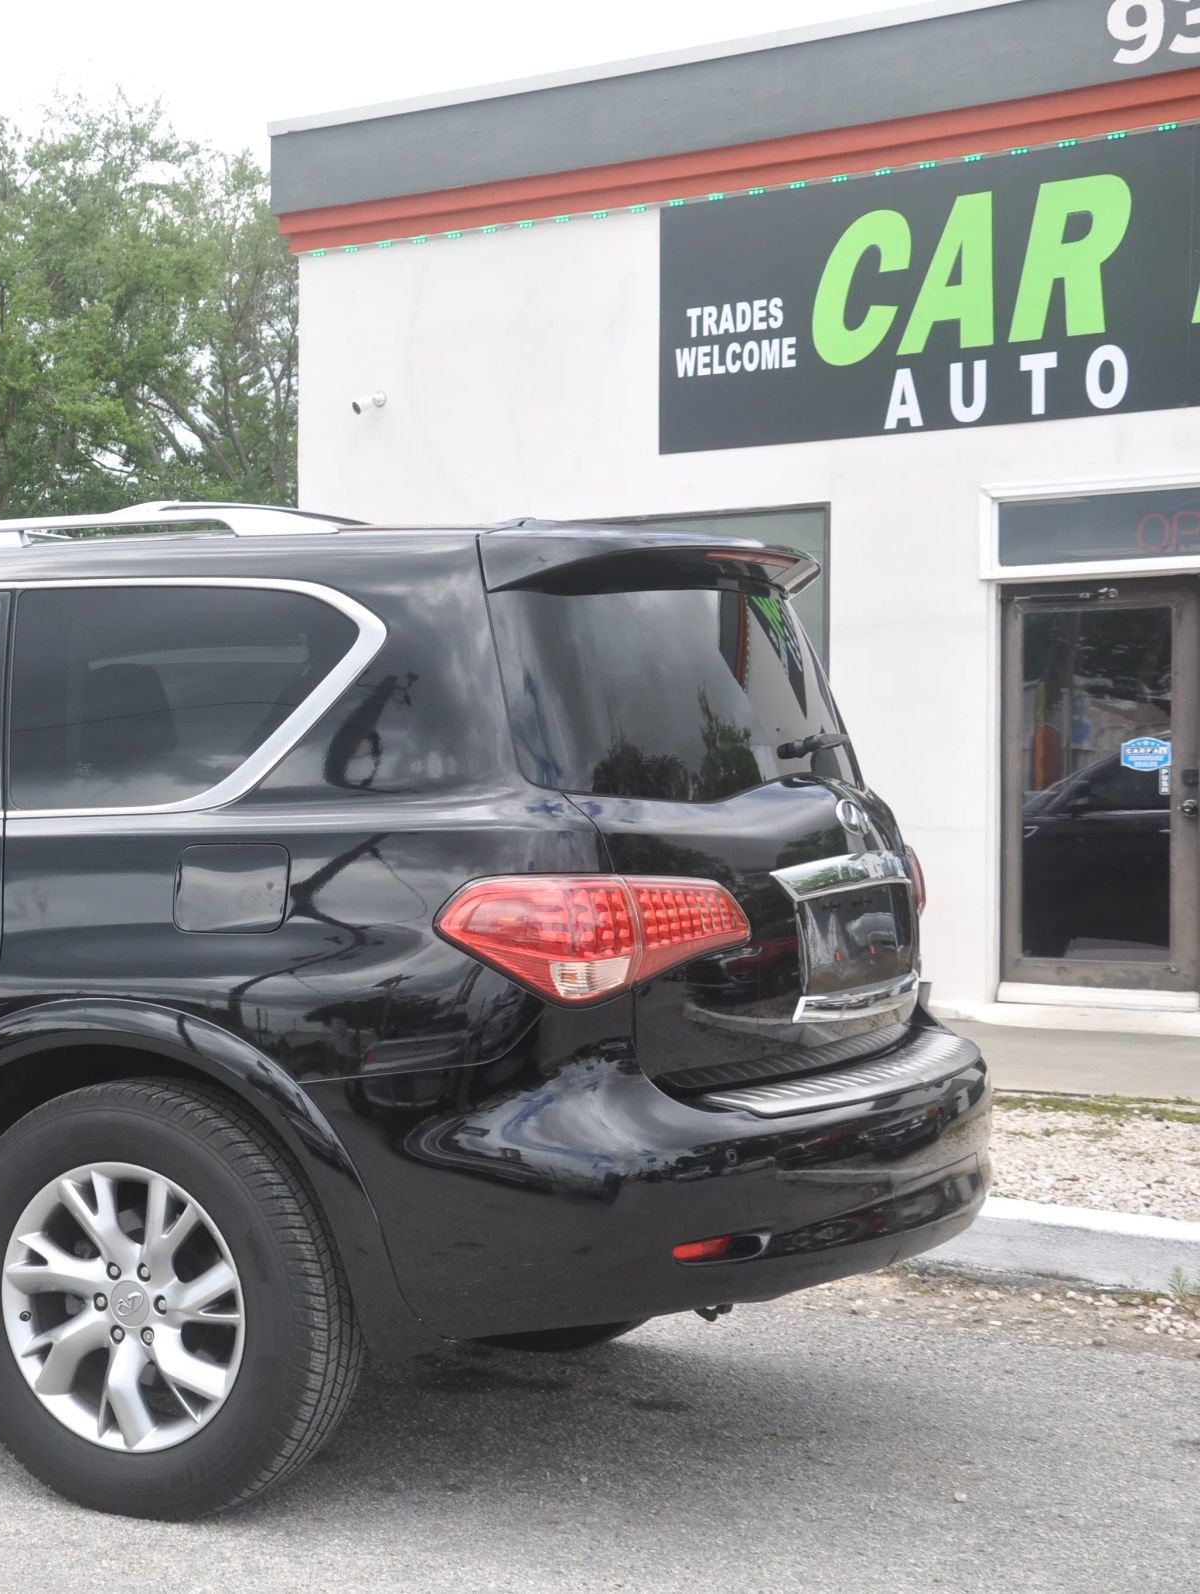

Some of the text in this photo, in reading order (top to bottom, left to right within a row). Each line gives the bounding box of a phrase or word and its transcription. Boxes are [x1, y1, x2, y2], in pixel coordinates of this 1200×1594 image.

[812, 174, 1133, 366] CAR
[686, 297, 784, 338] TRADES
[675, 336, 797, 378] WELCOME
[884, 344, 1129, 430] AUTO
